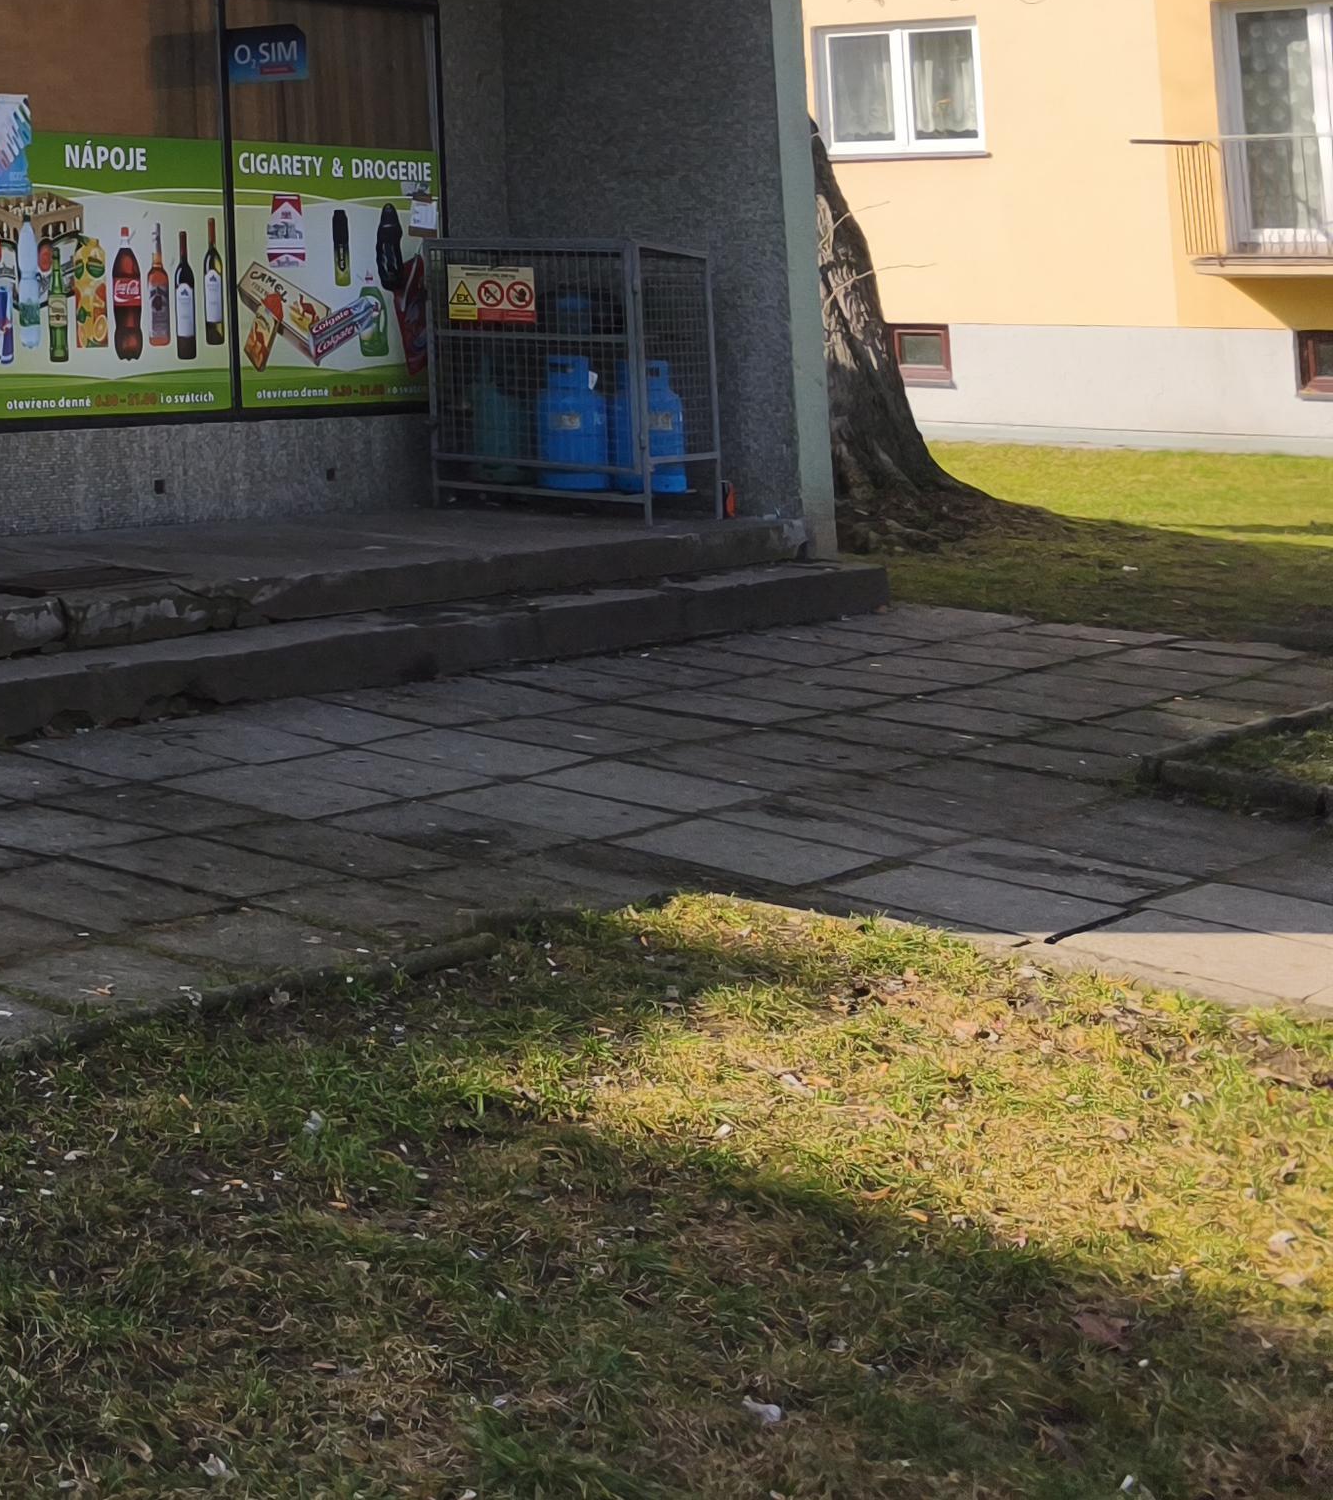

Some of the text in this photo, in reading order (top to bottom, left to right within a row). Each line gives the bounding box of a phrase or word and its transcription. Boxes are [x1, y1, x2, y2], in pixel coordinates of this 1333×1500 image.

[258, 40, 297, 63] SIM
[64, 140, 147, 172] NÁPOJE
[238, 152, 432, 183] CIGARETY & DROGERIE
[250, 271, 288, 303] CAMEL
[456, 294, 469, 303] EX
[312, 309, 351, 333] Colgate
[317, 325, 354, 354] Colgate
[5, 397, 56, 411] otevřeno
[58, 395, 92, 409] denně
[174, 390, 215, 405] svátcích
